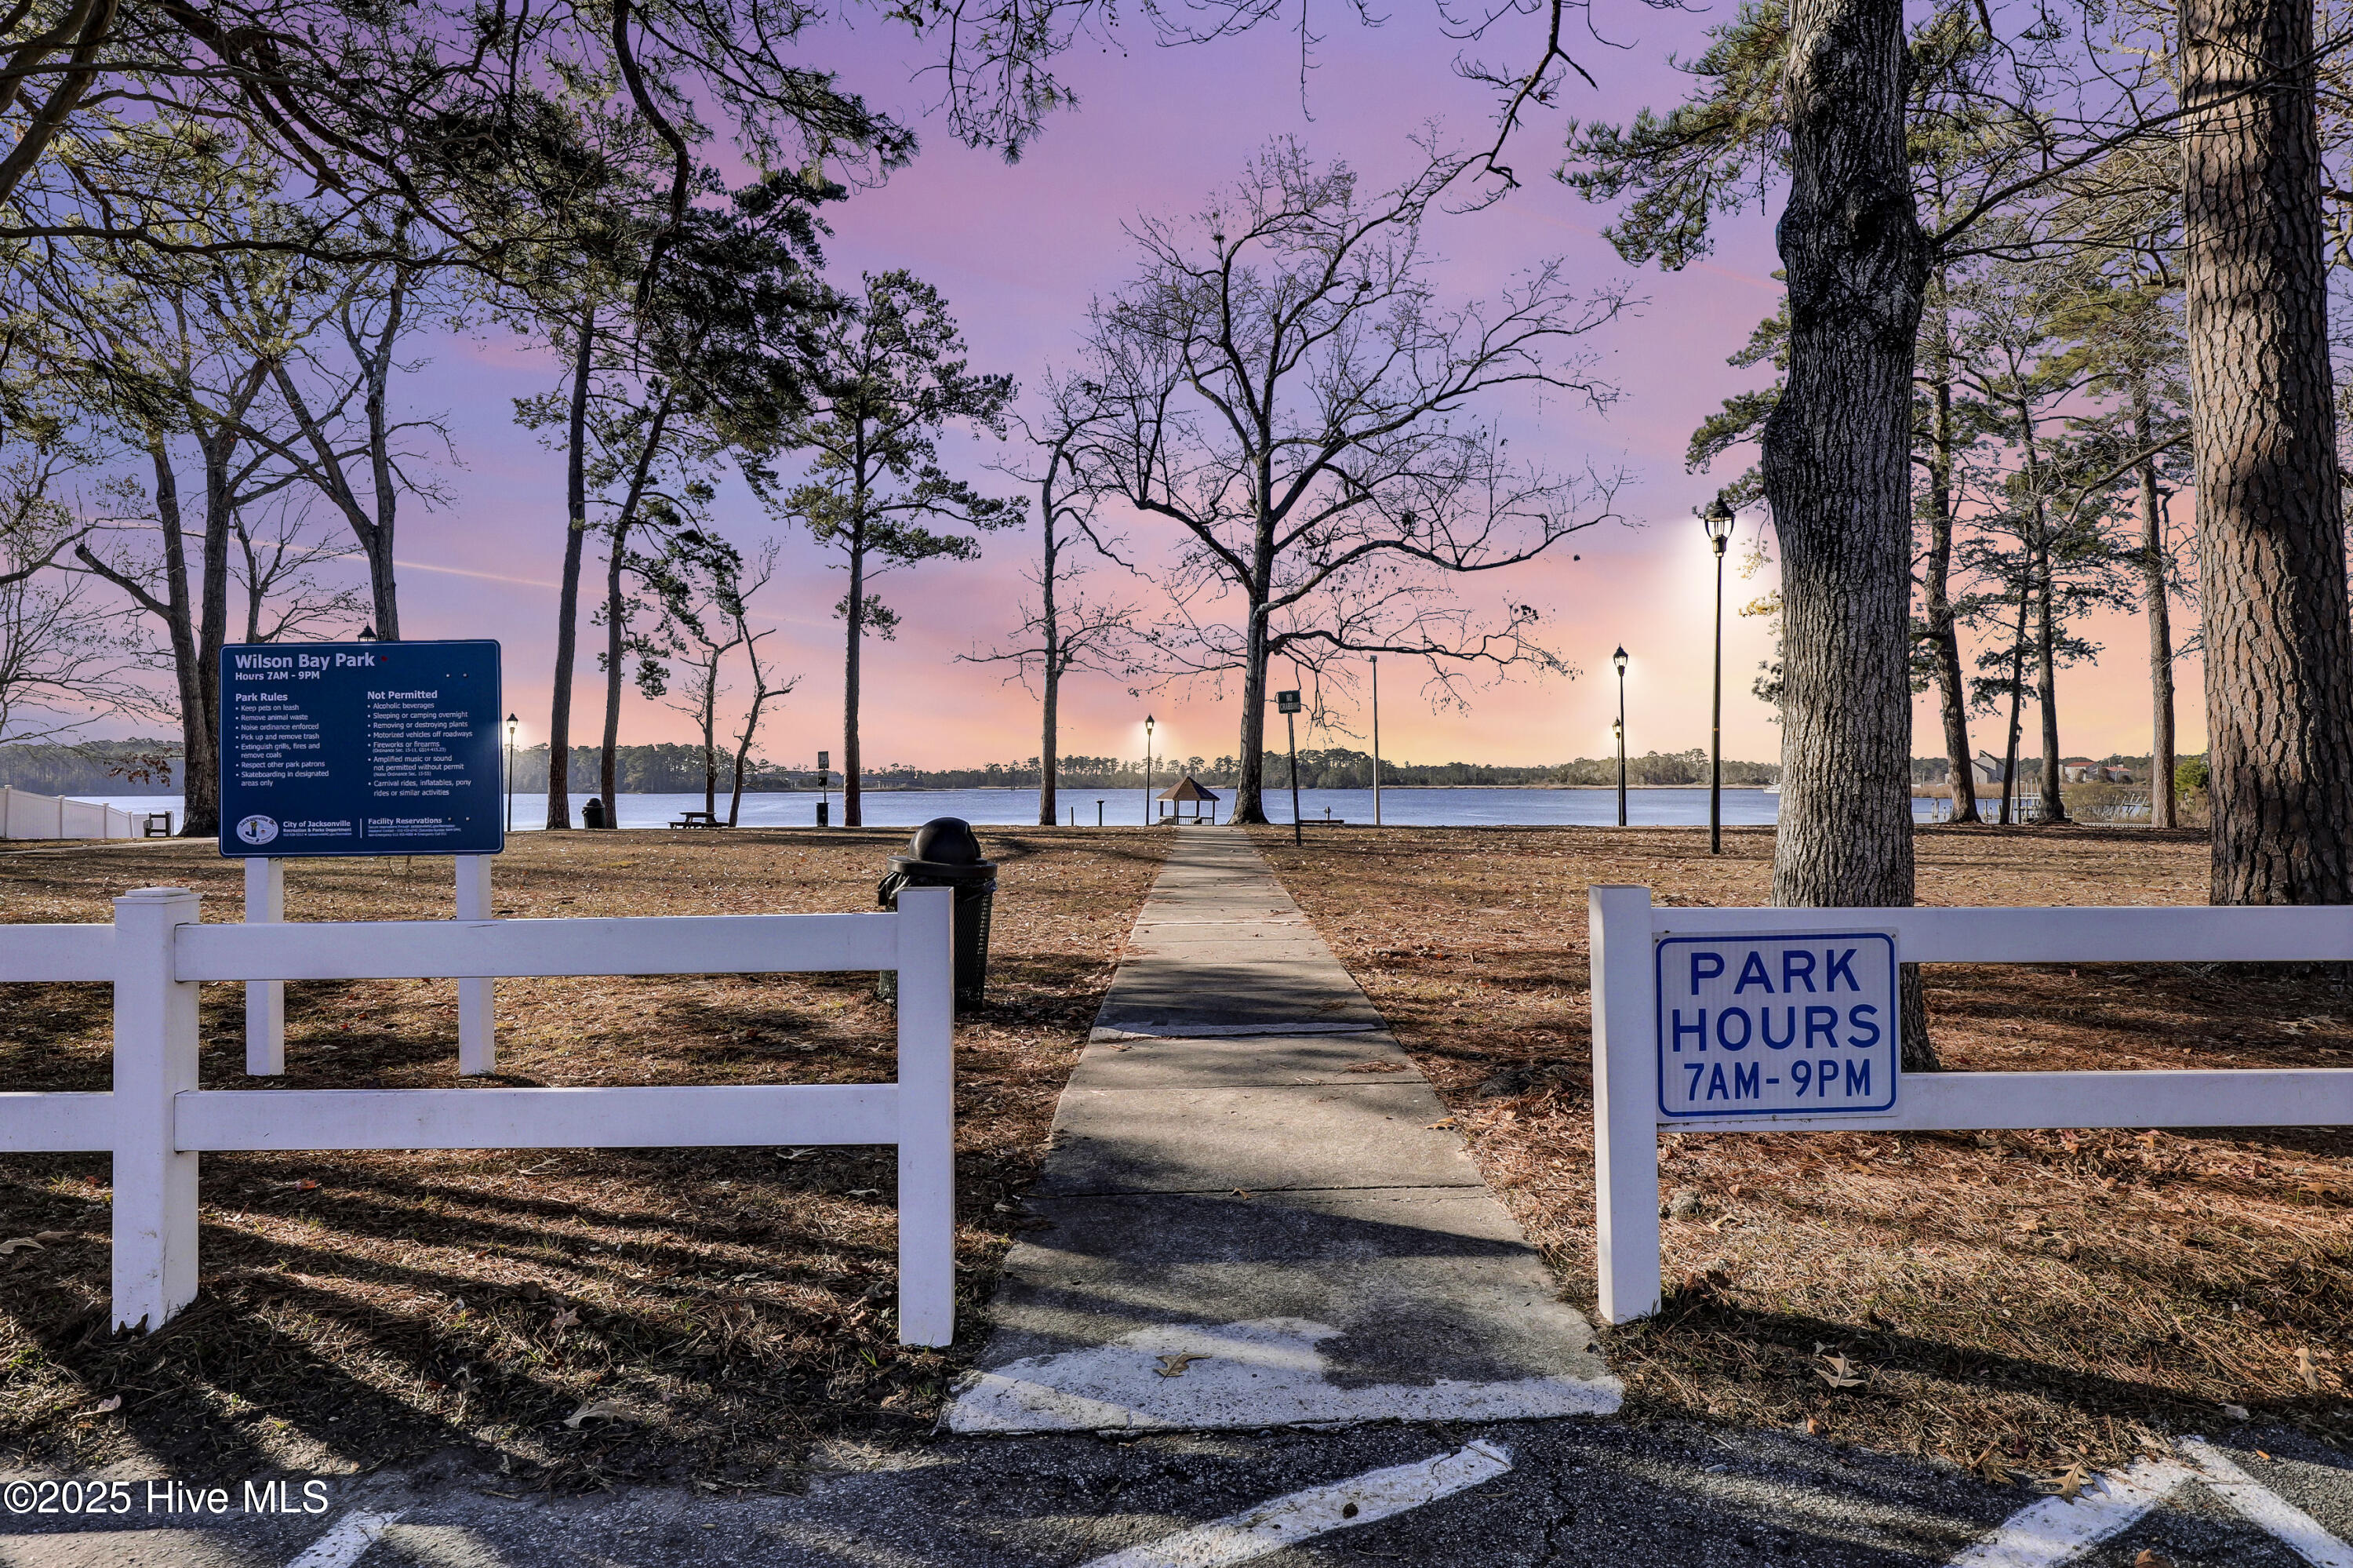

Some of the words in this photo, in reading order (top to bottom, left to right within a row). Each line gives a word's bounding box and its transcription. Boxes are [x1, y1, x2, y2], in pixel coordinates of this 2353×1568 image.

[235, 654, 293, 668] Wilson
[299, 654, 330, 671] Bay
[336, 653, 375, 667] Park
[299, 671, 320, 679] 9PM
[260, 693, 288, 701] Rules
[388, 690, 438, 699] Permitted
[1690, 948, 1860, 995] PARK
[1672, 1004, 1881, 1052] HOURS
